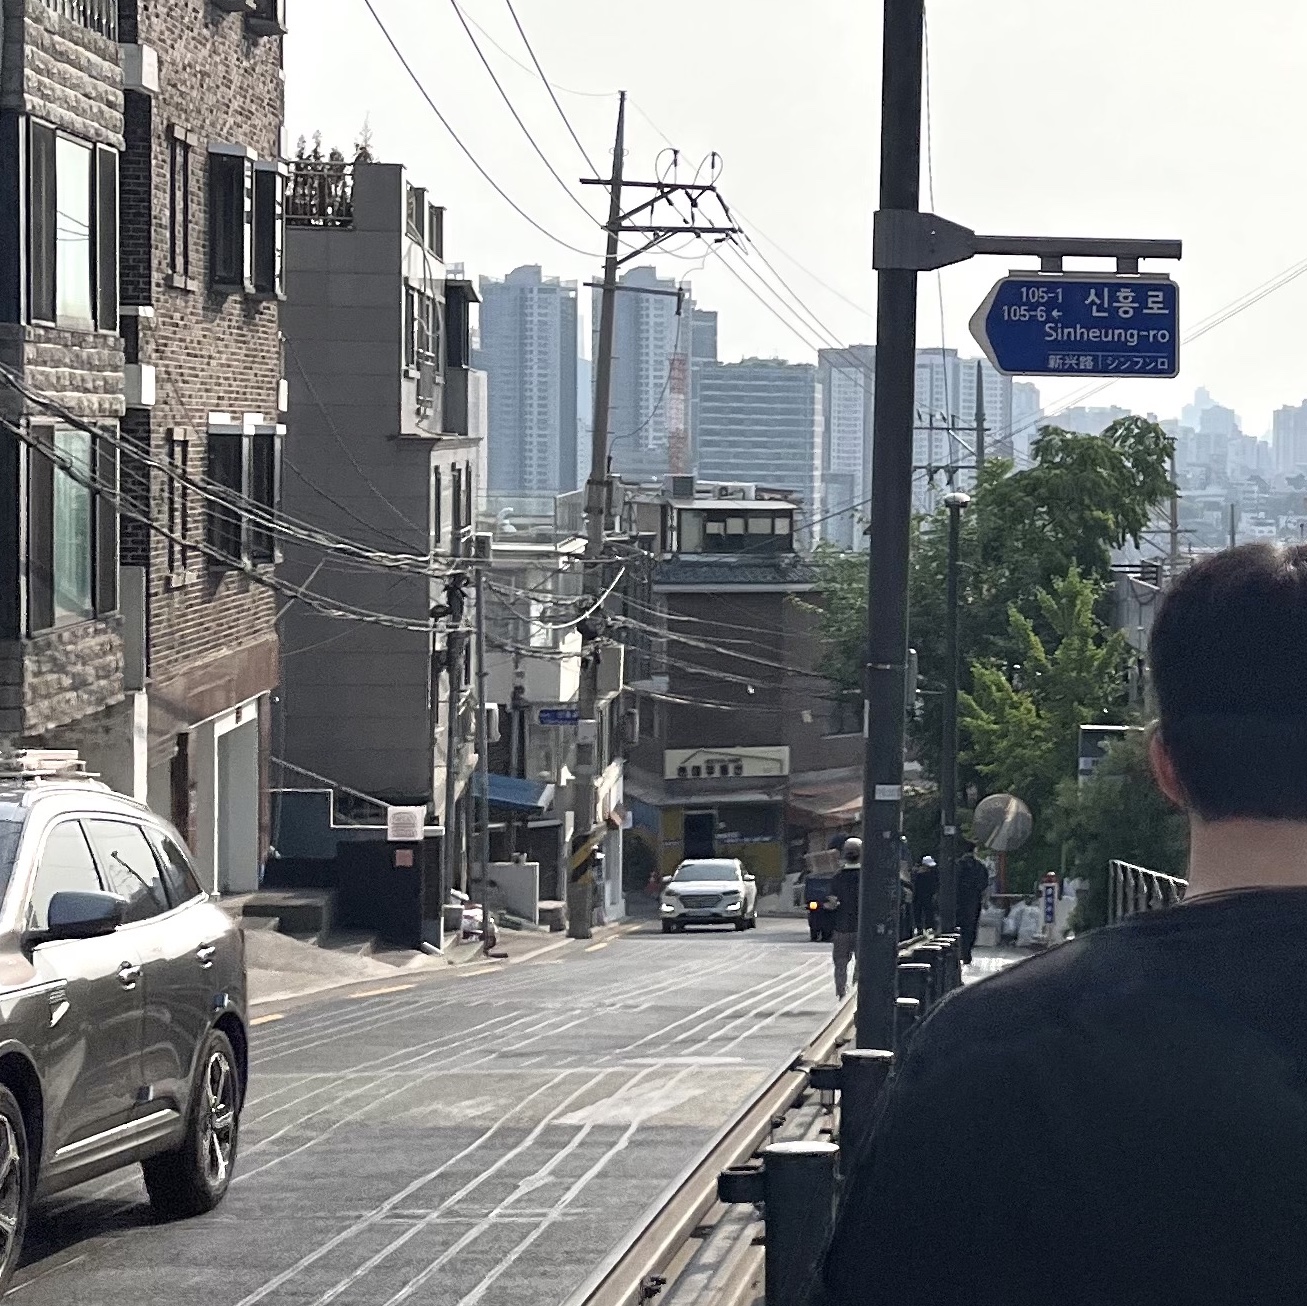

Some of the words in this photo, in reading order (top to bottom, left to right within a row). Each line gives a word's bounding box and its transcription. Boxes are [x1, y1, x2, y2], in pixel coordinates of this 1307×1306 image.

[1020, 286, 1063, 303] 105-1
[1084, 287, 1170, 319] 신흥로
[1002, 305, 1047, 321] 105-6
[1044, 323, 1170, 346] Sinheung-ro
[1047, 355, 1094, 370] 新兴路
